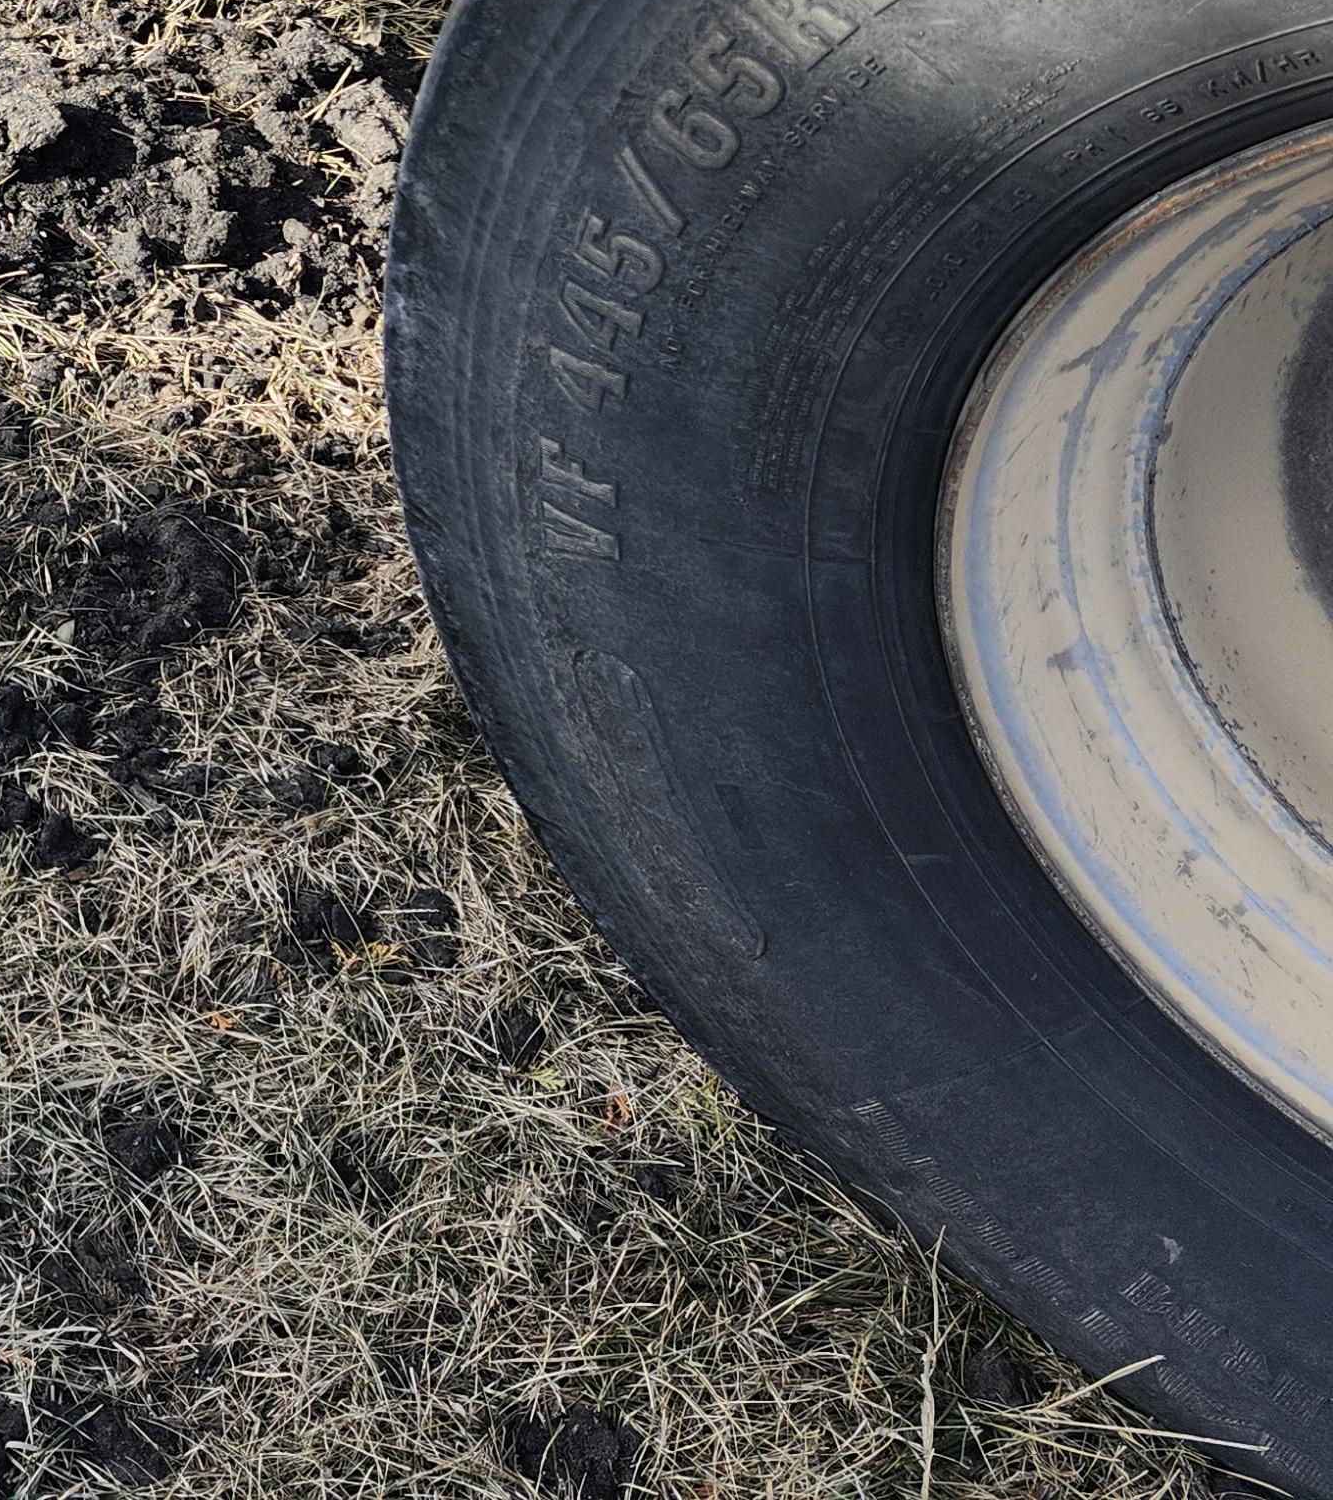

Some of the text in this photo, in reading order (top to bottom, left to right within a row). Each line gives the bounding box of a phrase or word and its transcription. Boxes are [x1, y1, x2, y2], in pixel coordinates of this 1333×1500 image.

[1139, 98, 1182, 124] 65
[658, 56, 888, 374] NOT FOR HIGHWAY SERVICE
[538, 432, 622, 562] VF
